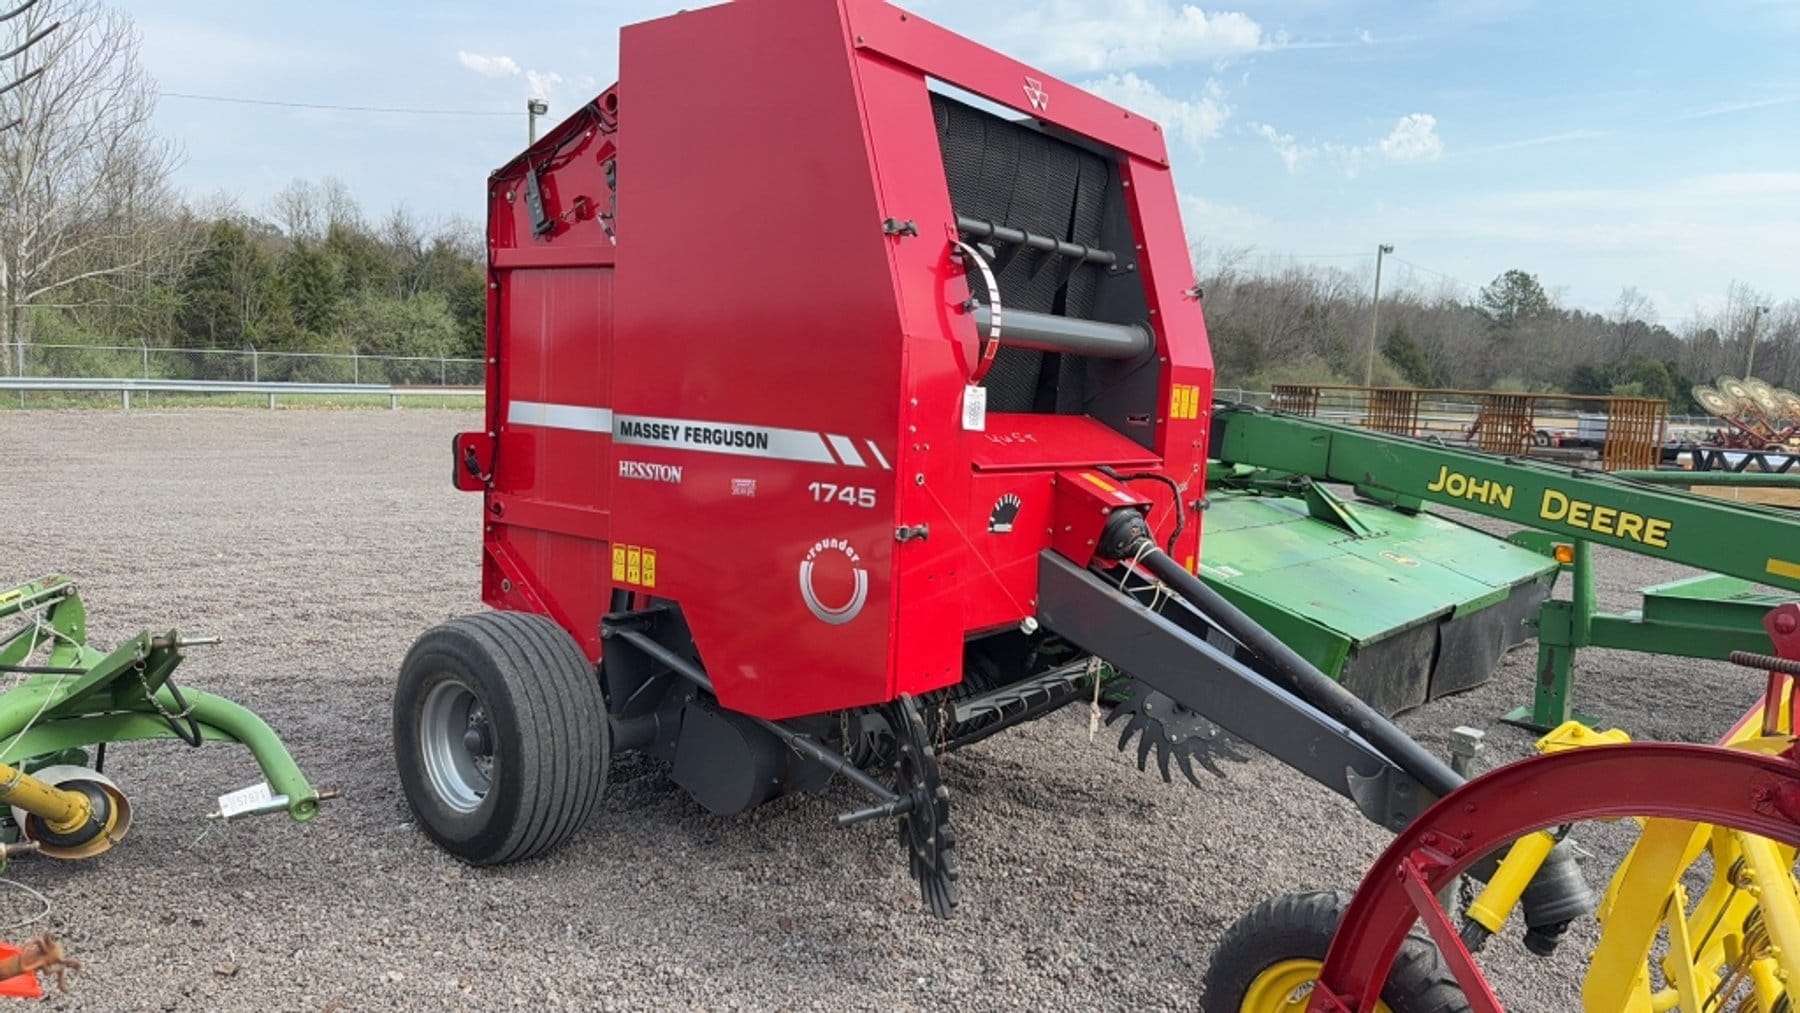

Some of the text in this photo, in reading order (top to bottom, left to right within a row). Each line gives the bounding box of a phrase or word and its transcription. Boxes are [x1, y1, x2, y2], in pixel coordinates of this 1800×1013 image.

[620, 420, 769, 449] MASSEY FERGUSON
[618, 460, 683, 484] HESSTON
[808, 482, 877, 509] 1745
[1427, 465, 1673, 549] JOHN DEERE
